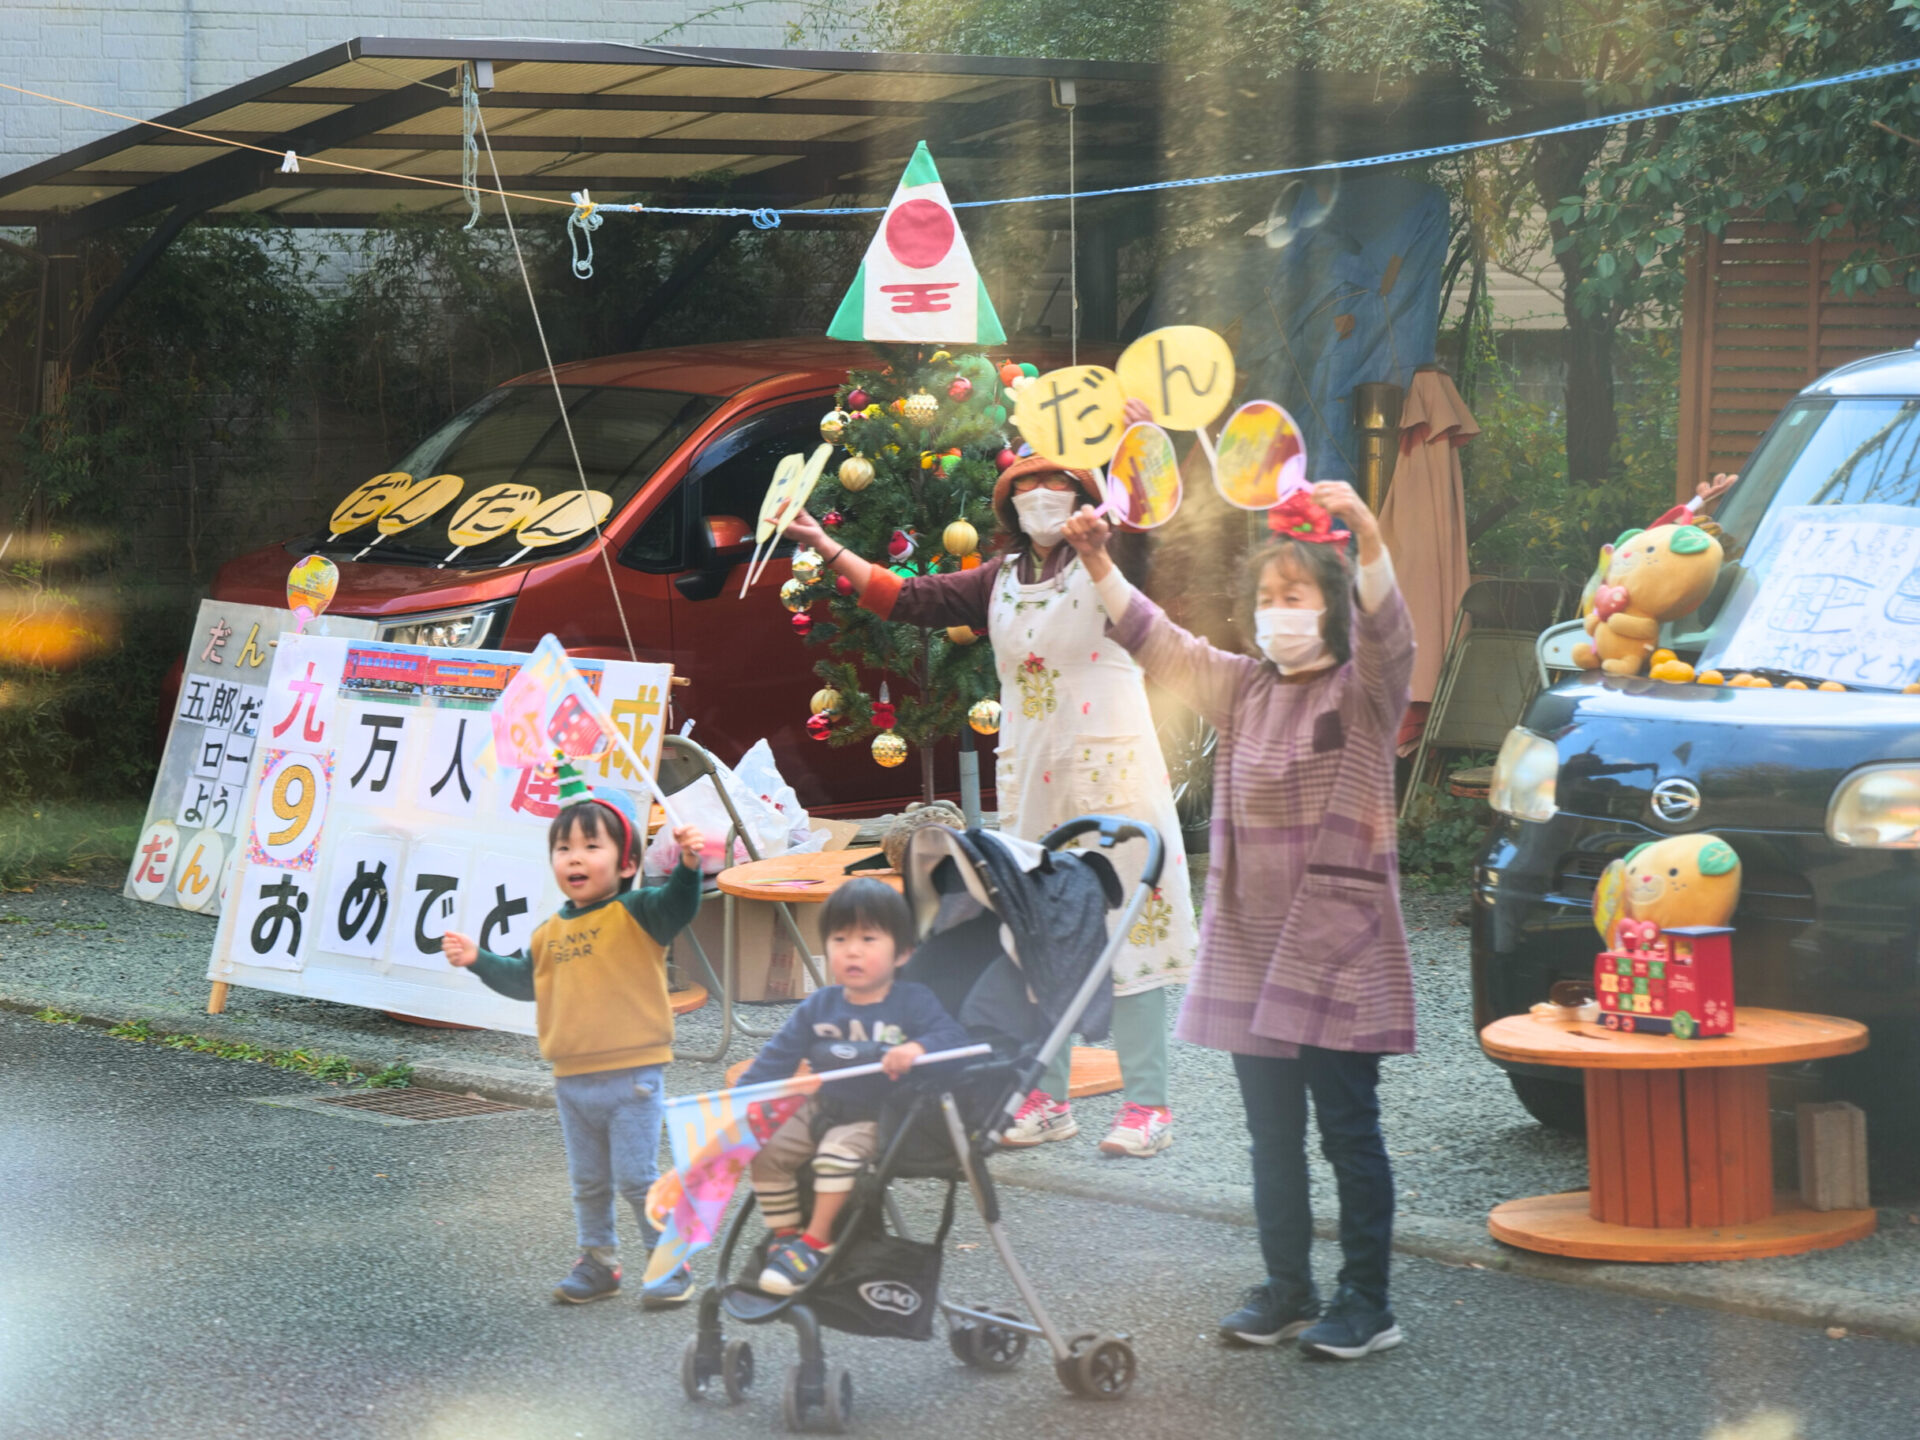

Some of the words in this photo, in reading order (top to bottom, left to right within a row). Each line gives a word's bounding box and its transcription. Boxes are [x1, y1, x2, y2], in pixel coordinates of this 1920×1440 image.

[1039, 339, 1218, 456] だん
[180, 681, 263, 737] 五郎だ
[184, 784, 229, 827] よう
[554, 943, 593, 964] BEAR
